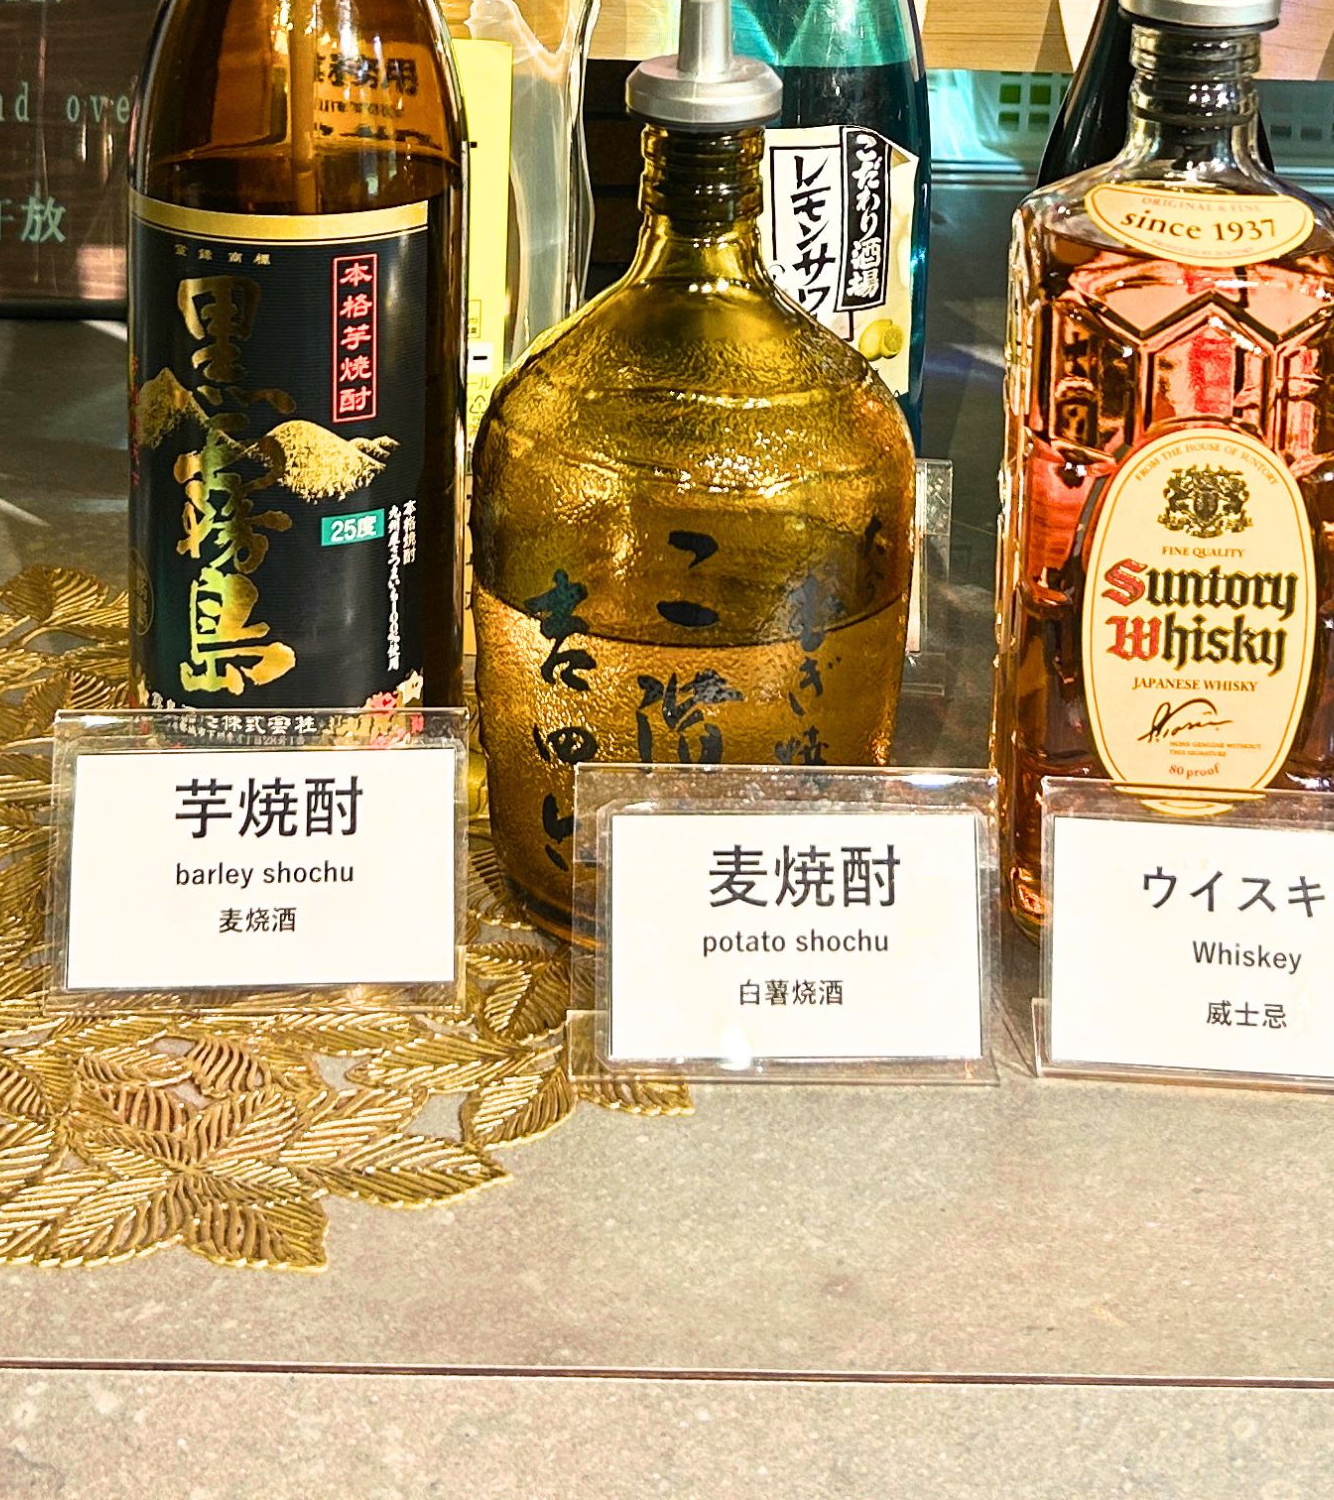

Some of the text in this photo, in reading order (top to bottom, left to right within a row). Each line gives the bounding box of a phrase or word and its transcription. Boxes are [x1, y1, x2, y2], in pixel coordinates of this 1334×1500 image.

[66, 99, 131, 126] ove
[846, 133, 883, 299] こだわり酒場
[1120, 209, 1276, 242] since 1937
[338, 261, 373, 413] 本格芋焼酎
[1134, 442, 1280, 486] FROM THE HOUSE OF SUNTORY
[330, 512, 378, 542] 25度
[1161, 545, 1245, 559] FINE QUALITY
[1100, 557, 1300, 622] Suntory
[1104, 610, 1288, 678] Whisky
[1132, 676, 1259, 692] JAPANESE WHISKY
[1168, 762, 1221, 780] 80 proof
[175, 775, 363, 839] 芋焼酎
[175, 860, 355, 889] barley shochu
[708, 843, 902, 909] 麦焼酎
[218, 907, 297, 934] 麦烧酒
[702, 928, 889, 958] potato shochu
[1192, 940, 1303, 975] Whiskey
[1205, 1000, 1288, 1030] 威士忌
